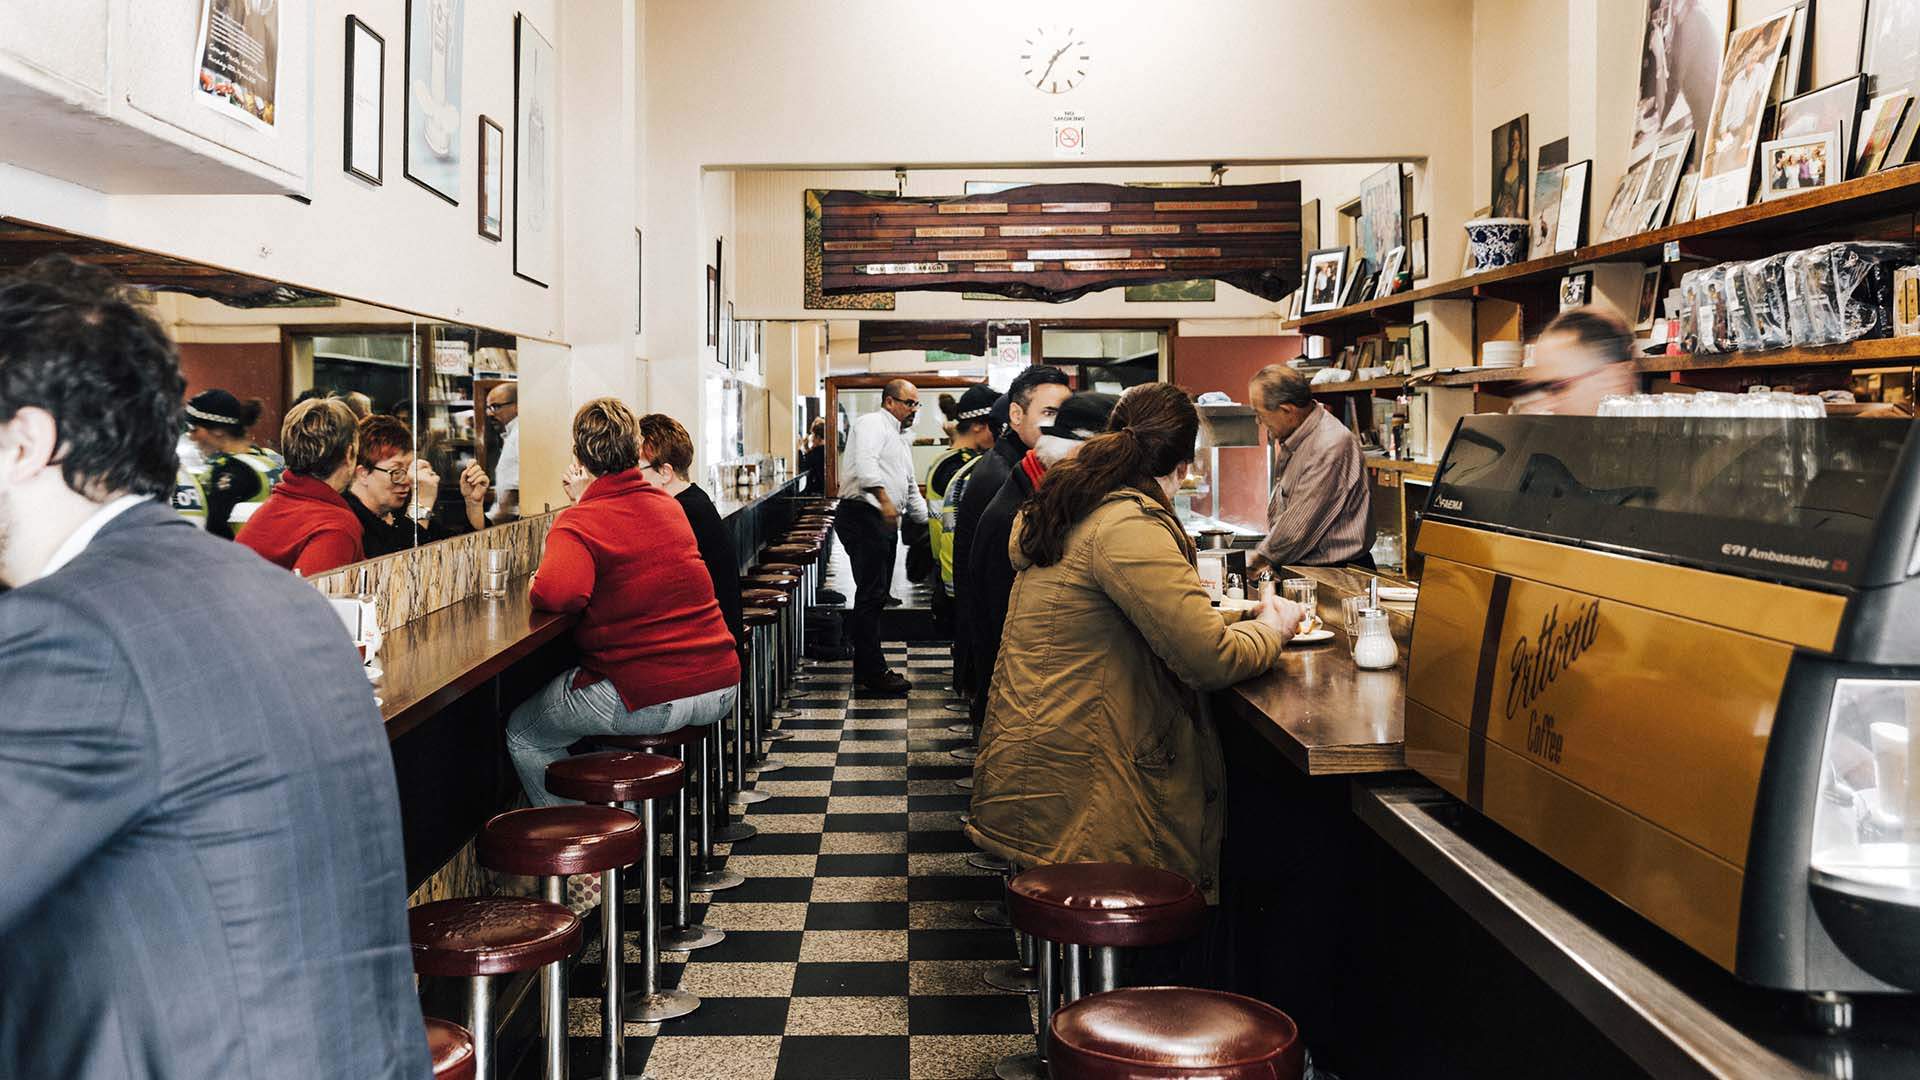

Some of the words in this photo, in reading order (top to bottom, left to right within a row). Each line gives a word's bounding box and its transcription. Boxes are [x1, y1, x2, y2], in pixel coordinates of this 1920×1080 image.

[1439, 498, 1463, 512] FAEMA
[1748, 547, 1830, 570] Ambassador
[1527, 708, 1564, 764] Coffee
